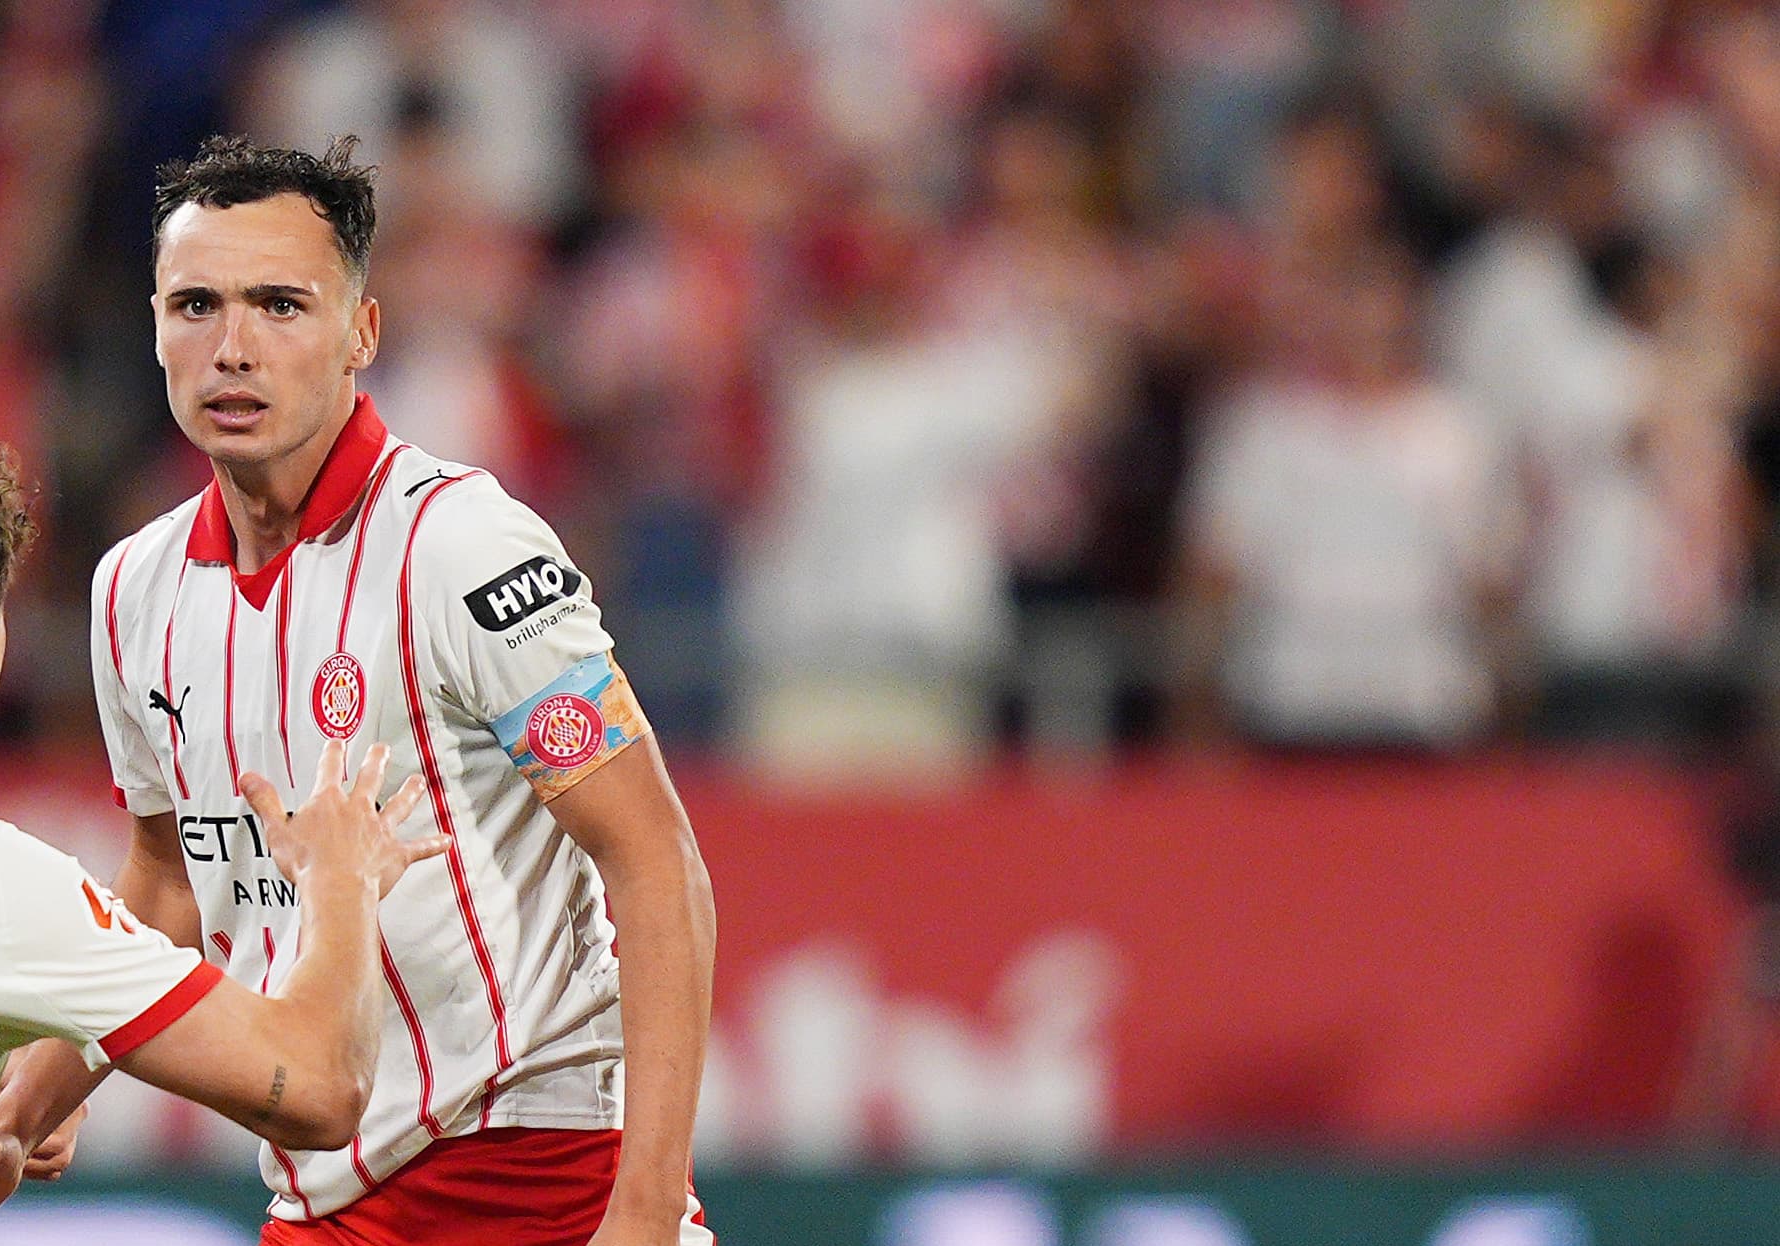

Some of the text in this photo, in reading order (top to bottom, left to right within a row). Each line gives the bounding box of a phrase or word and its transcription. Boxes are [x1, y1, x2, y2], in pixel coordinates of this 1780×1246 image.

[486, 562, 564, 622] HYLO
[321, 656, 359, 679] GIRONA
[530, 697, 573, 731] GIRONA
